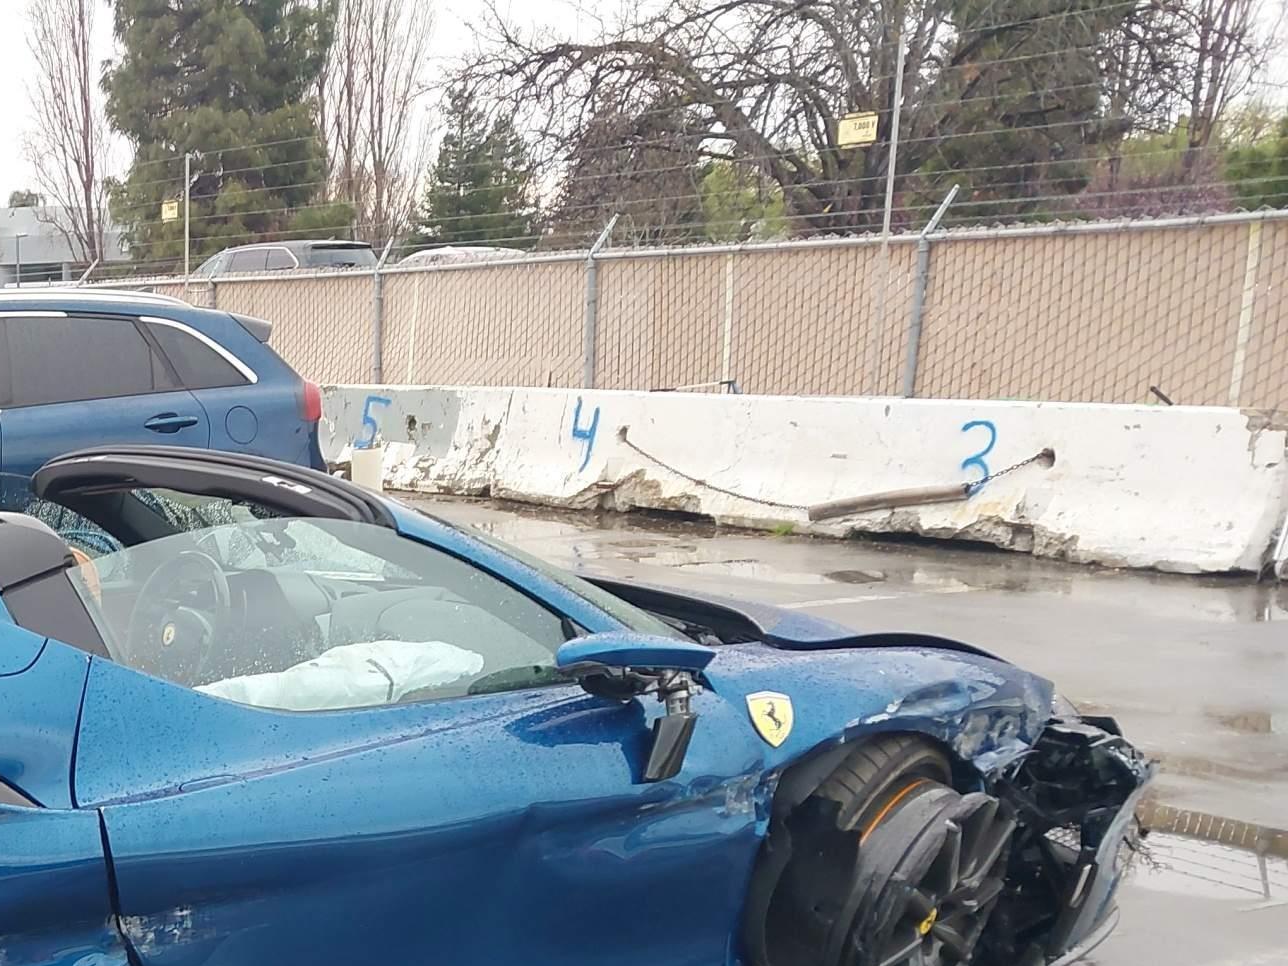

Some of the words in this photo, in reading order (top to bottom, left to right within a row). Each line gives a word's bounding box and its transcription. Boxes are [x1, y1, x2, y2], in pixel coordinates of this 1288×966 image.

[353, 395, 392, 449] 5
[573, 396, 600, 473] 4
[961, 420, 997, 499] 3
